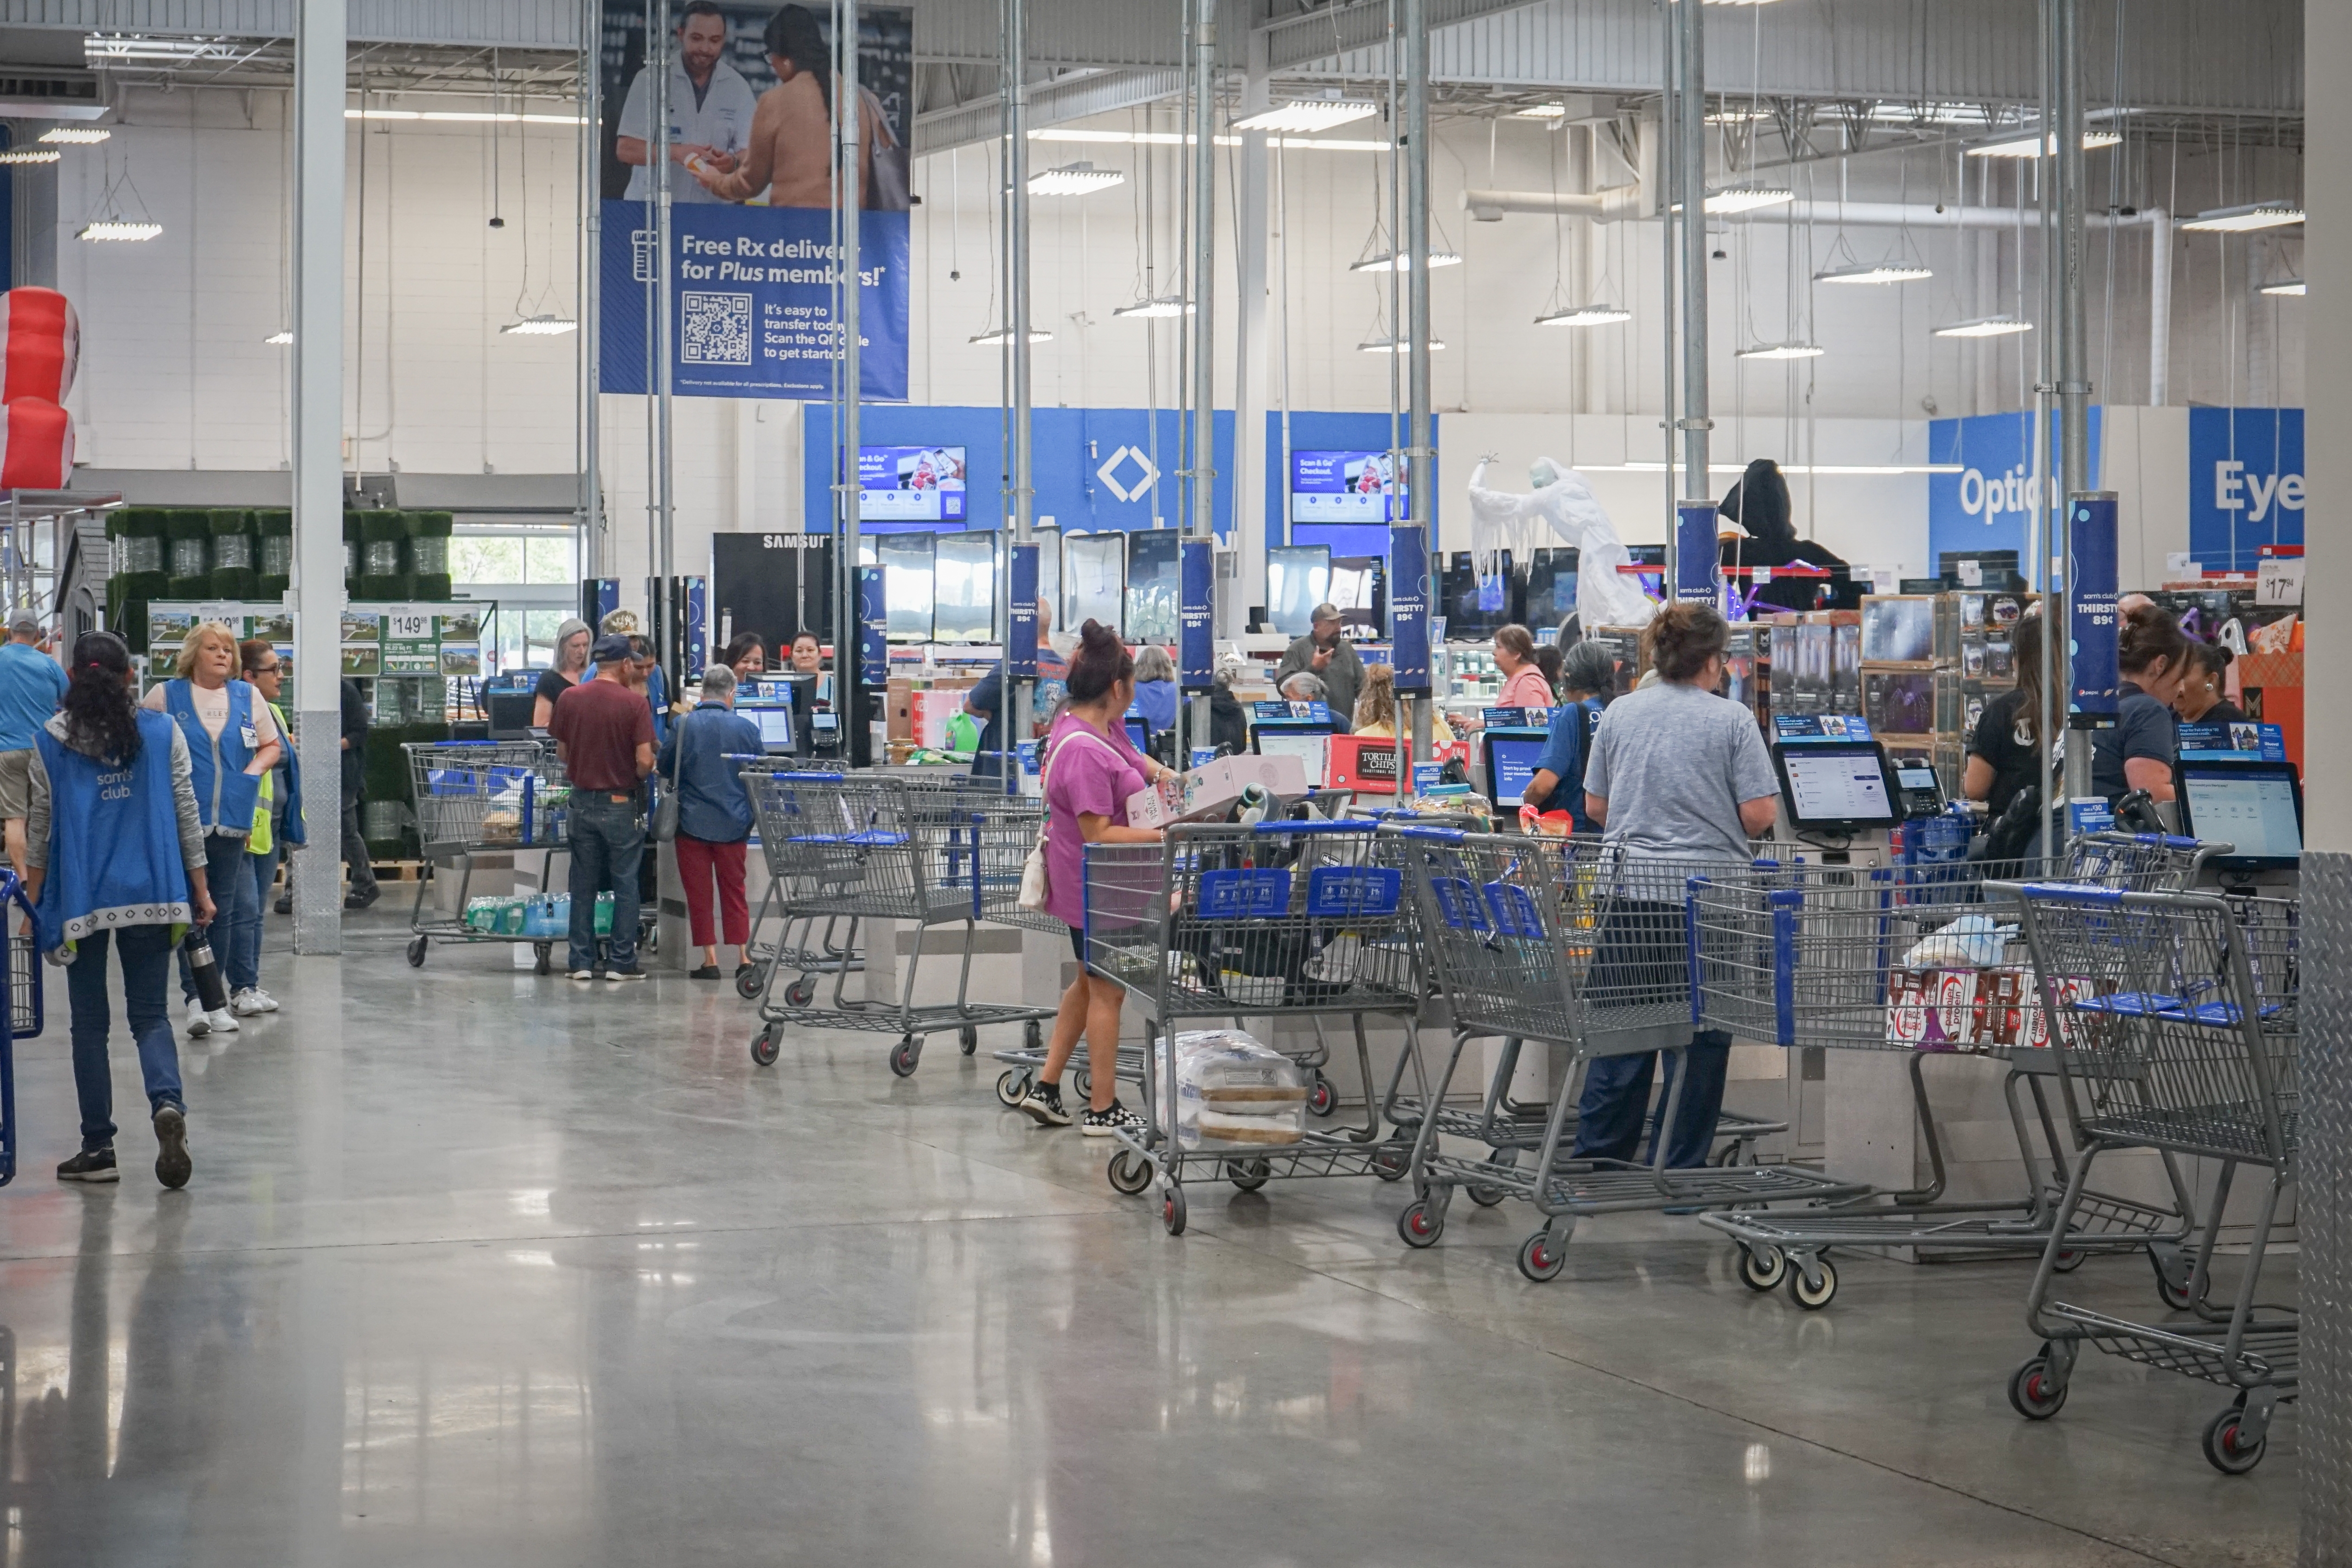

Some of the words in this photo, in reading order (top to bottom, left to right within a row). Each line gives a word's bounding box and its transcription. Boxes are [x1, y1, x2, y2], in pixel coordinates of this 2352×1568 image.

[683, 235, 731, 256] Free
[737, 237, 765, 257] Rx
[681, 260, 714, 280] for
[720, 261, 764, 282] Plus
[785, 306, 812, 319] easy
[814, 306, 827, 317] to
[764, 319, 811, 330] transfer
[764, 332, 793, 344] Scan
[795, 333, 816, 345] the
[764, 346, 777, 358] to
[779, 348, 800, 360] get
[2216, 460, 2305, 522] Eye
[2093, 615, 2113, 625] 89¢
[1370, 761, 1395, 769] CHIPS
[101, 785, 130, 800] club
